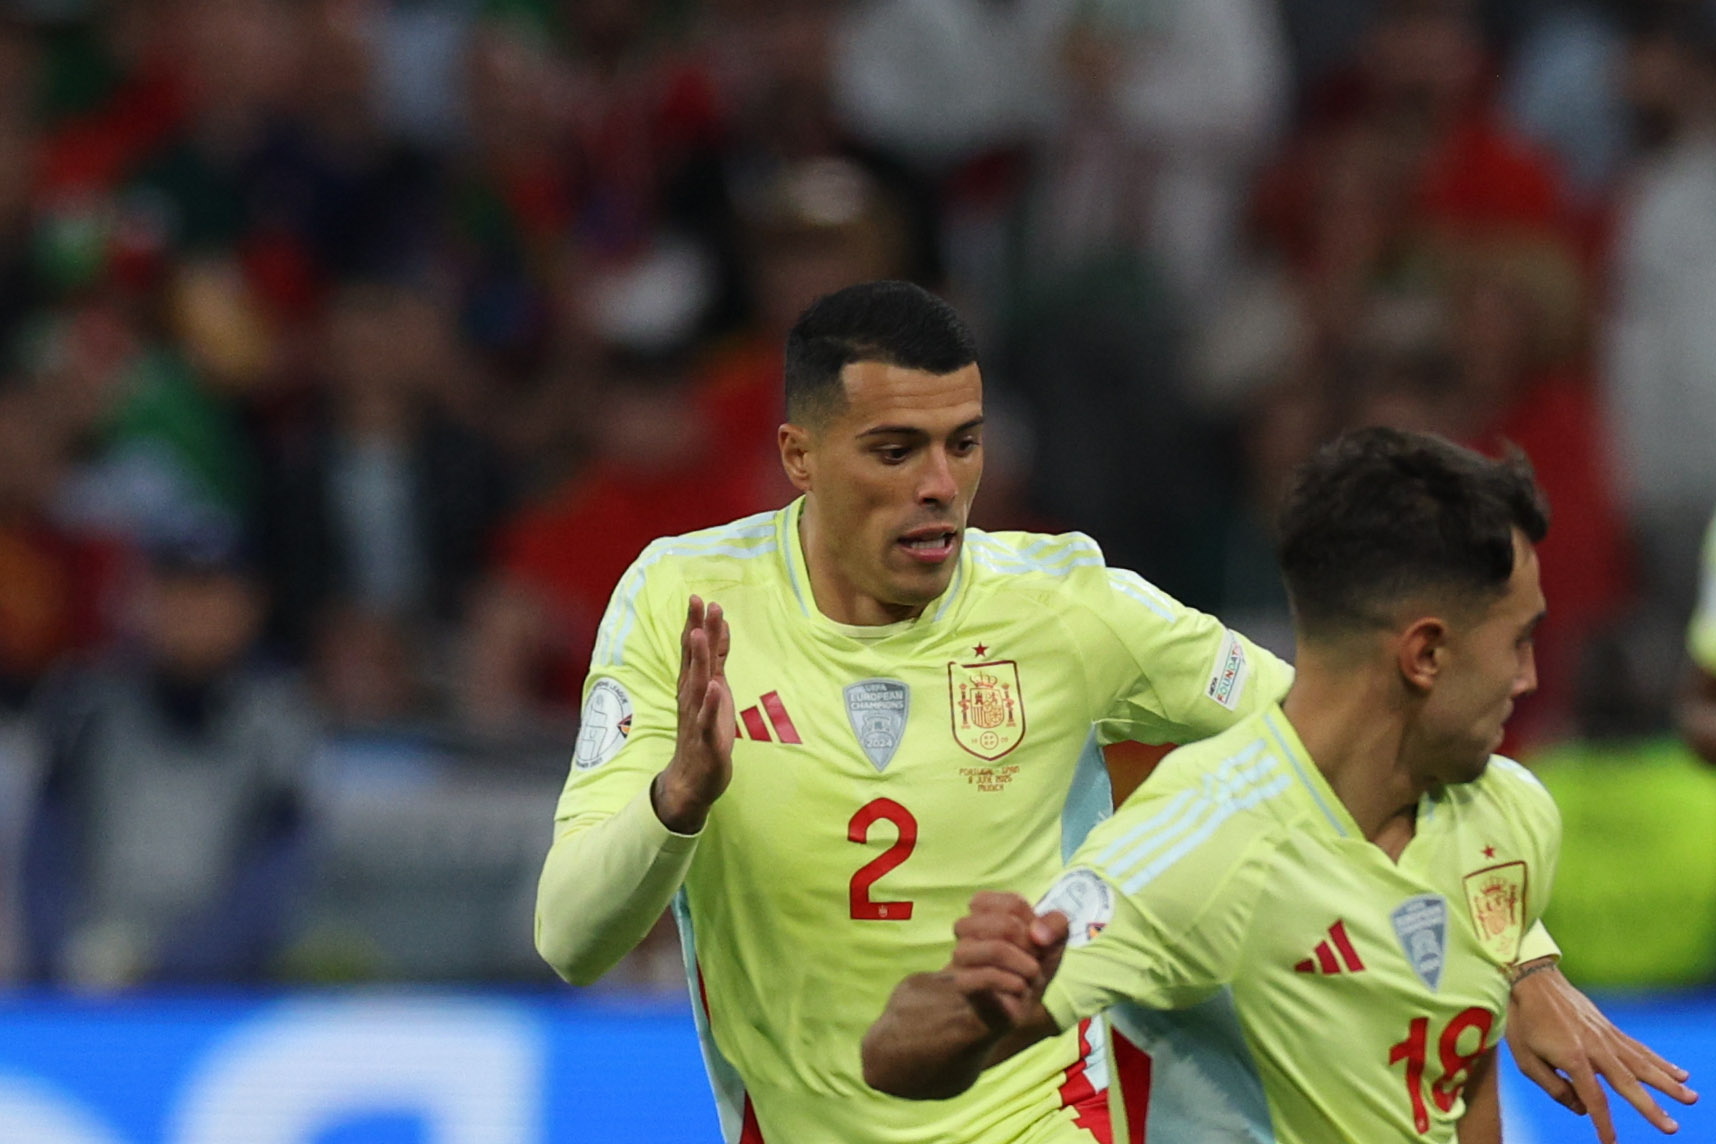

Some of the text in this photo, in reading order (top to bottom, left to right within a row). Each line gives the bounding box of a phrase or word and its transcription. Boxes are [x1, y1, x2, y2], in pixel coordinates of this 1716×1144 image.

[850, 690, 904, 701] EUROPEAN
[850, 701, 904, 710] CHAMPIONS
[847, 797, 918, 920] 2
[1389, 1006, 1493, 1134] 18
